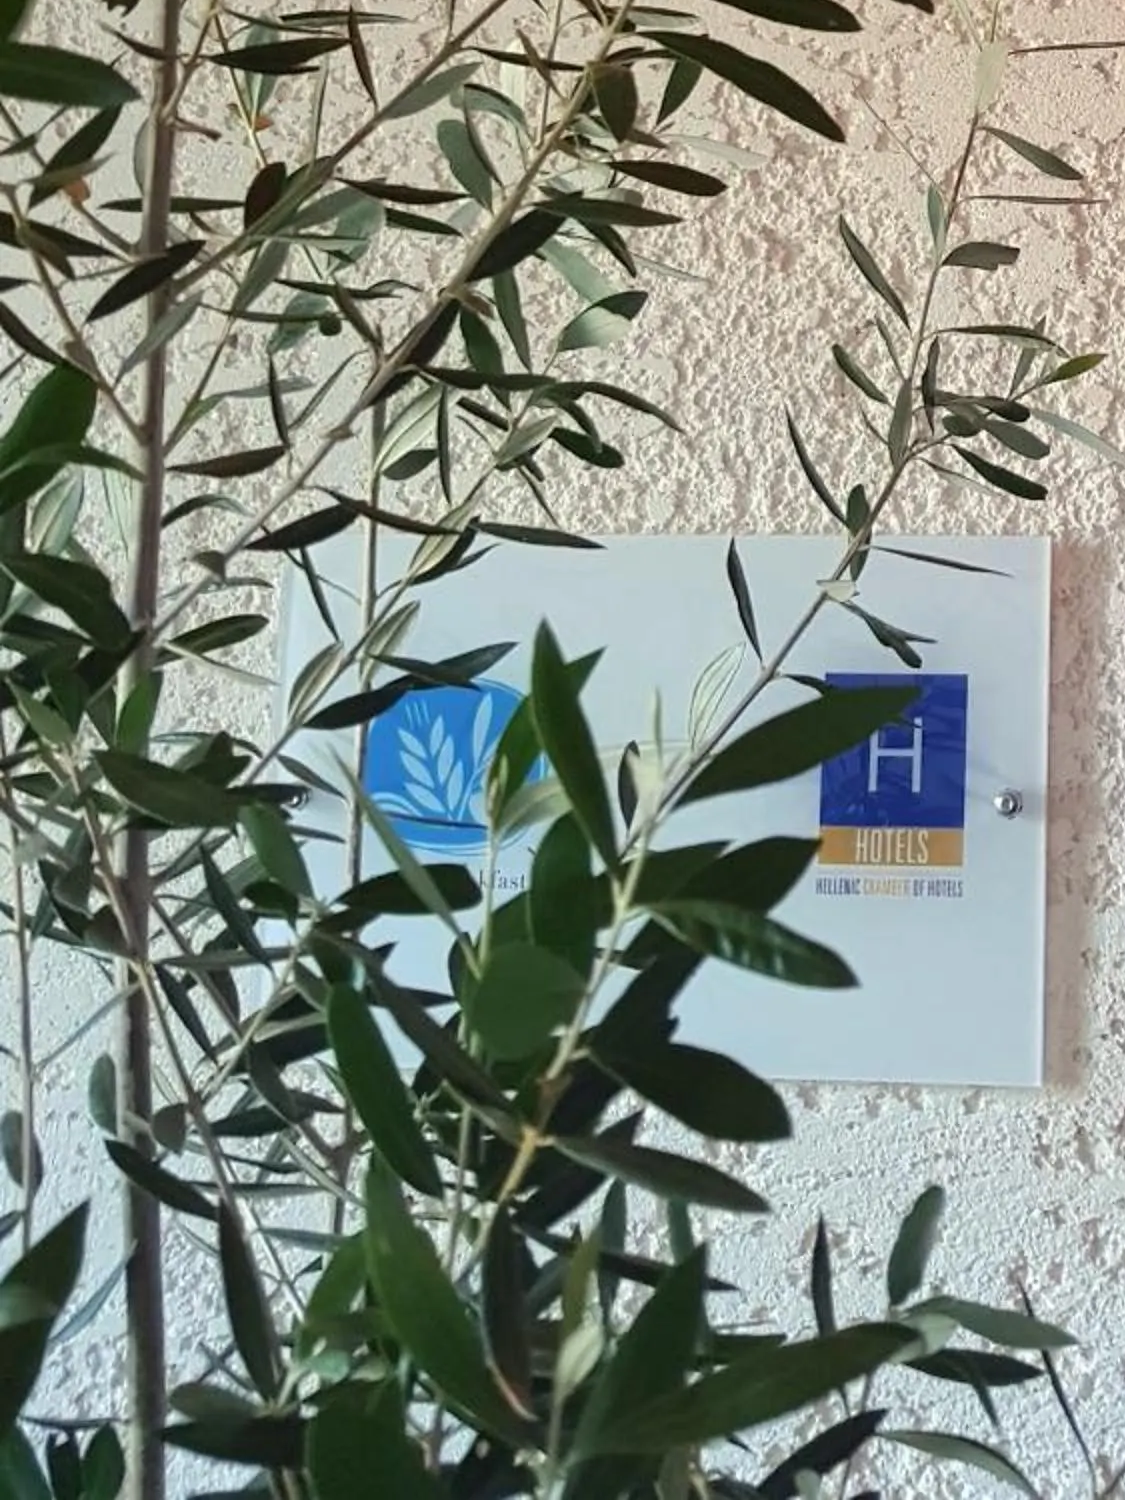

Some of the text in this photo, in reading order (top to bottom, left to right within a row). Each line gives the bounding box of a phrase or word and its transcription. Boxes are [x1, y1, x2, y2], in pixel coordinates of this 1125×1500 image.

[855, 827, 930, 864] HOTELS
[816, 877, 861, 896] HELLENIC
[912, 879, 925, 897] OF
[927, 880, 964, 898] HOTELS
